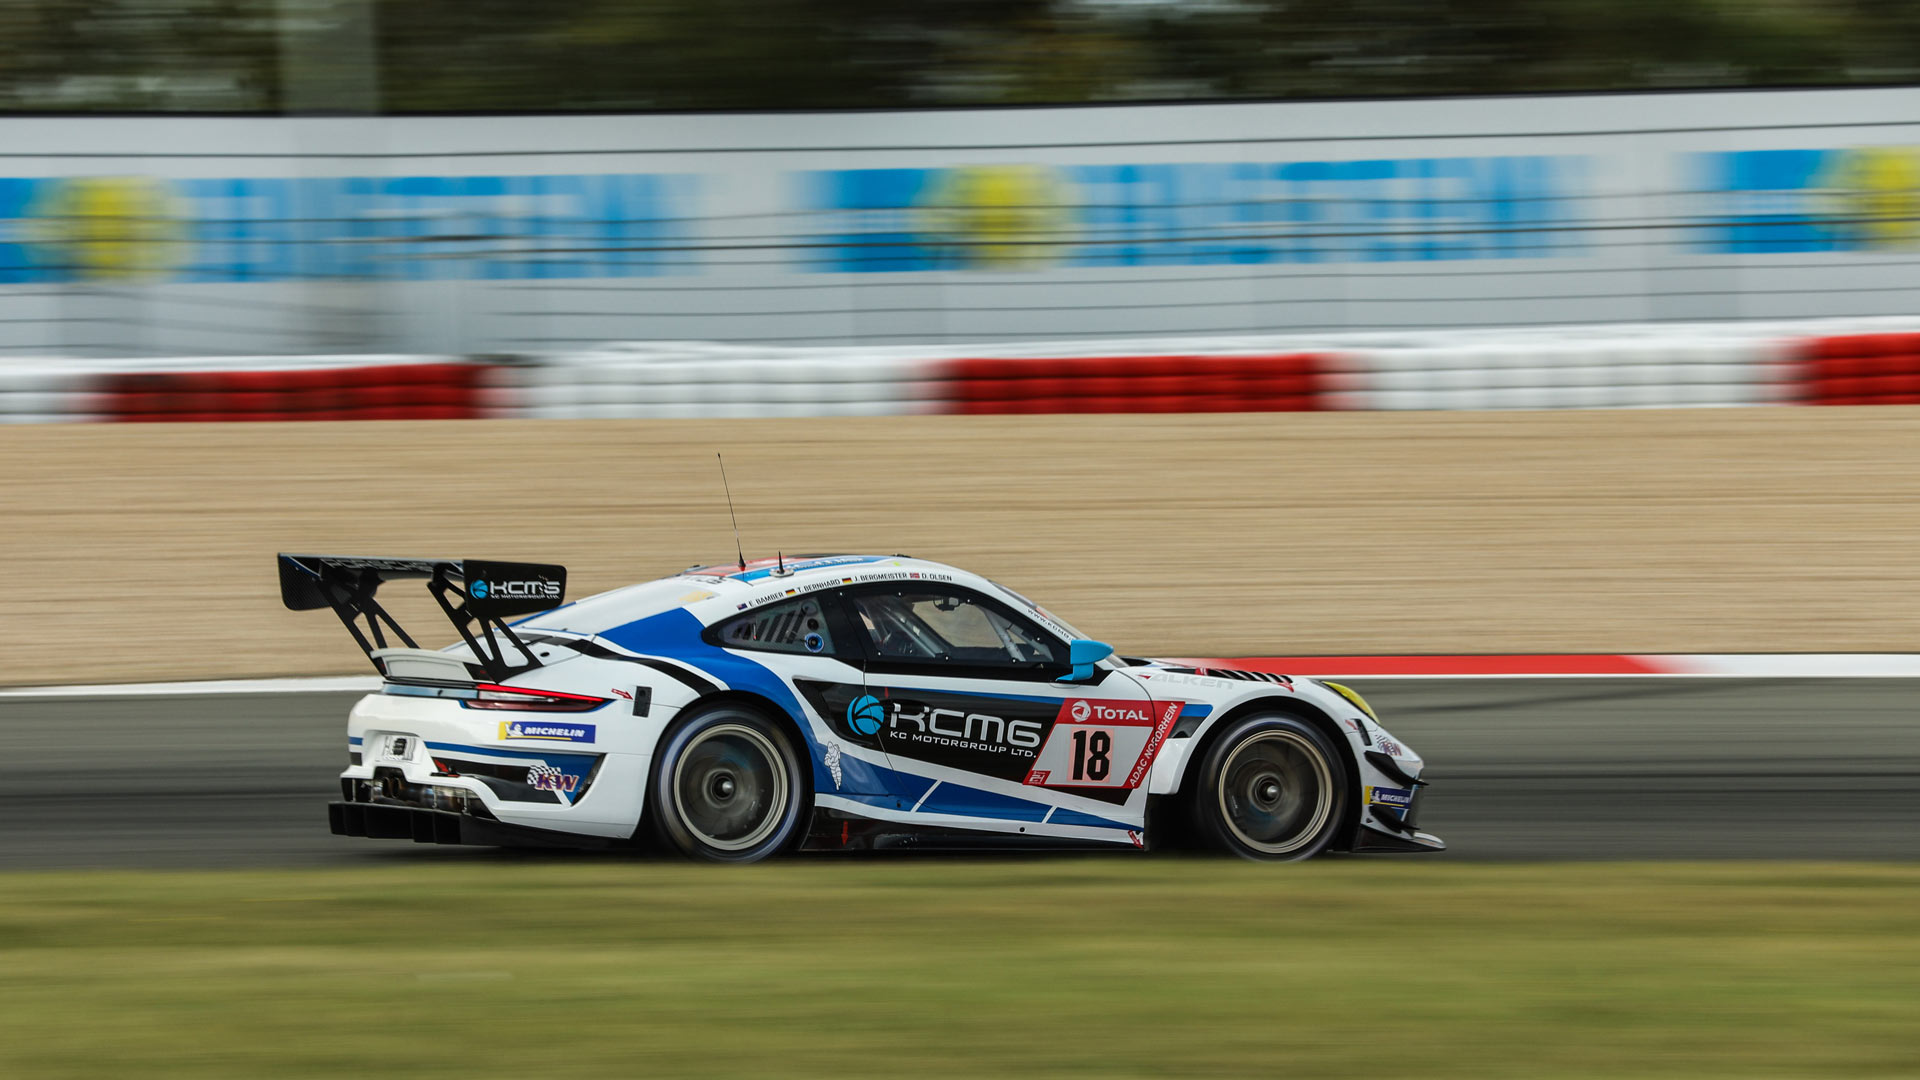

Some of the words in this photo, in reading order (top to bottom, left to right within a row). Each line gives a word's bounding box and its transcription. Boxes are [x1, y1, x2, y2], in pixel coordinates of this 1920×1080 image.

[860, 572, 907, 582] BERGMEISTER
[929, 573, 953, 581] OLSEN
[490, 581, 560, 595] KCMG
[804, 578, 840, 592] BERNHARD
[756, 592, 784, 606] BAMBER
[1093, 706, 1149, 721] TOTAL
[524, 726, 585, 738] MICHELIN
[890, 702, 1042, 748] KCMG
[890, 730, 907, 740] KC
[912, 734, 1007, 753] MOTORGROUP
[1011, 748, 1037, 759] LTD.
[1130, 759, 1148, 787] ADAC
[1146, 702, 1178, 760] NORDRHEIN
[1072, 730, 1111, 781] 18
[535, 774, 579, 792] KW
